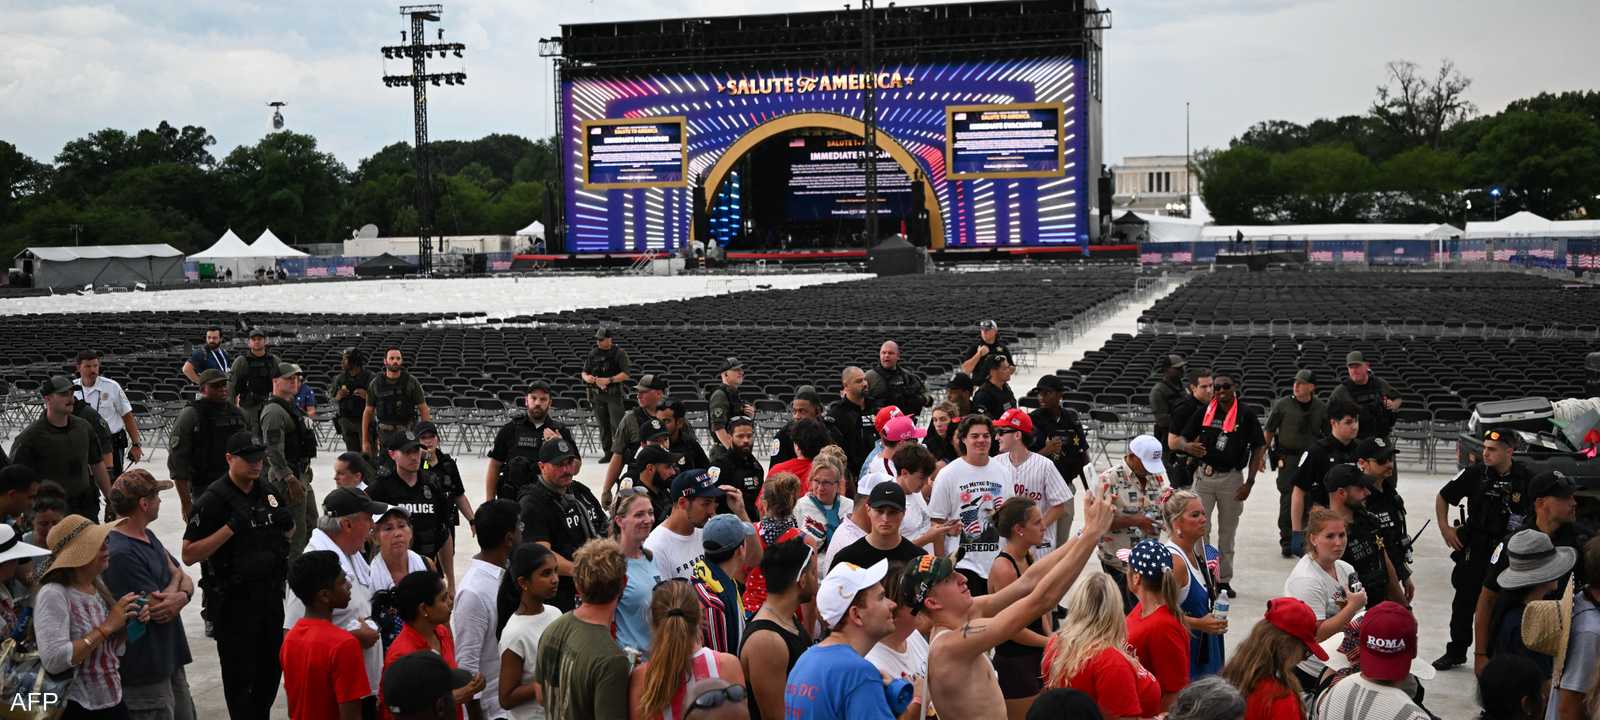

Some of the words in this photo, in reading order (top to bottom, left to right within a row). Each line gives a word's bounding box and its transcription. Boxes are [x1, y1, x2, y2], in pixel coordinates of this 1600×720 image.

[726, 77, 794, 95] SALUTE
[819, 72, 903, 90] AMERICA
[810, 151, 857, 160] IMMEDIATE
[398, 503, 434, 514] POLICE
[566, 507, 597, 528] POCE
[1367, 635, 1405, 648] ROMA
